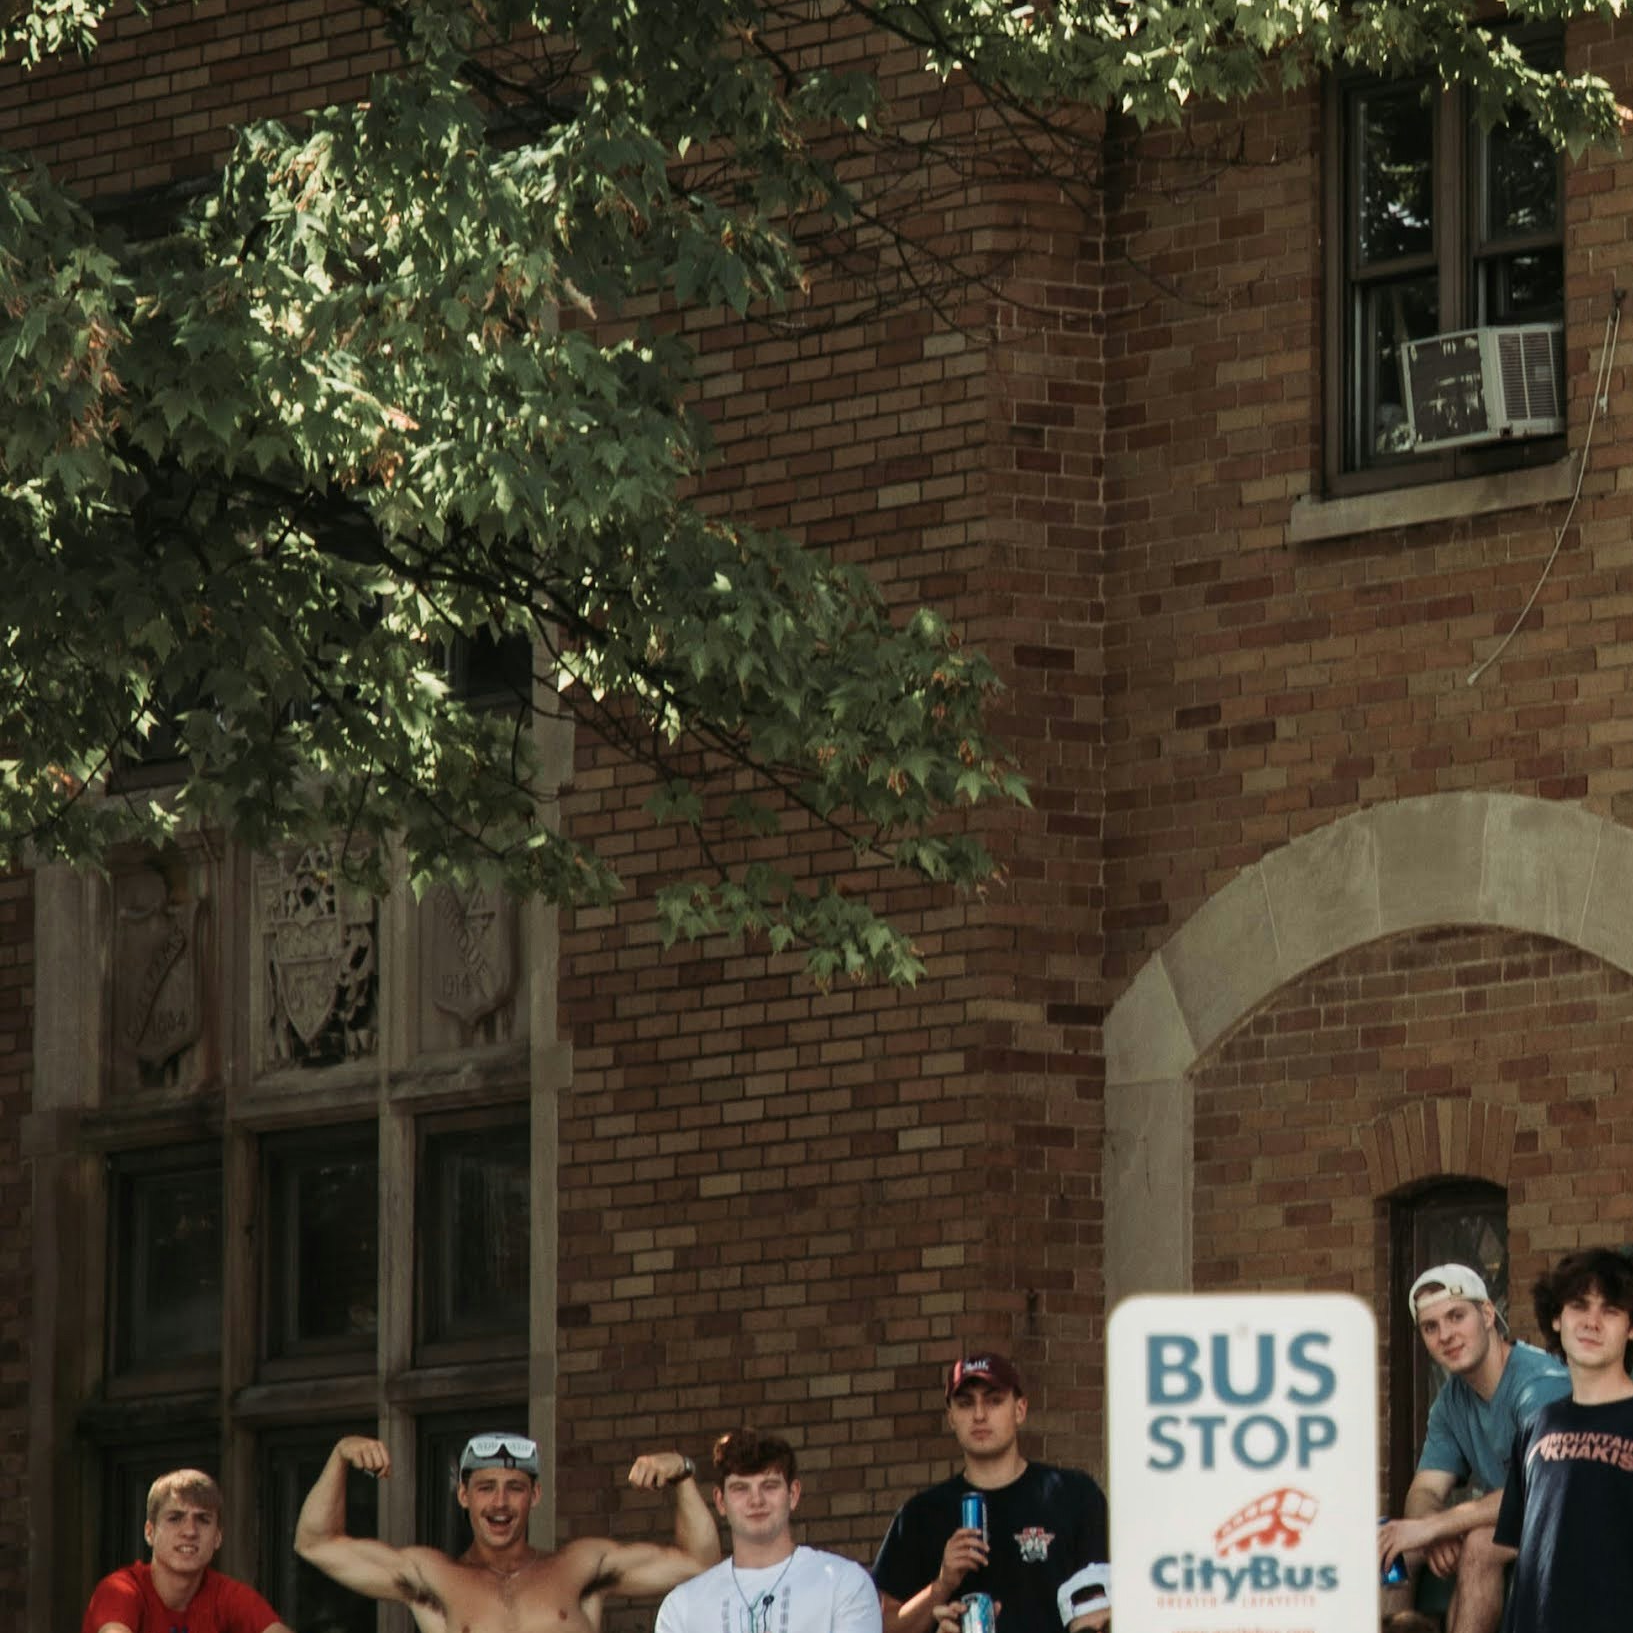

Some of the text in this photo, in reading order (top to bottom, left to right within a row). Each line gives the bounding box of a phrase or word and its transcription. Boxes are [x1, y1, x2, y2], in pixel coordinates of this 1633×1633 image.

[1145, 1332, 1337, 1408] BUS
[1146, 1413, 1339, 1472] STOP
[1150, 1553, 1340, 1603] CityBus
